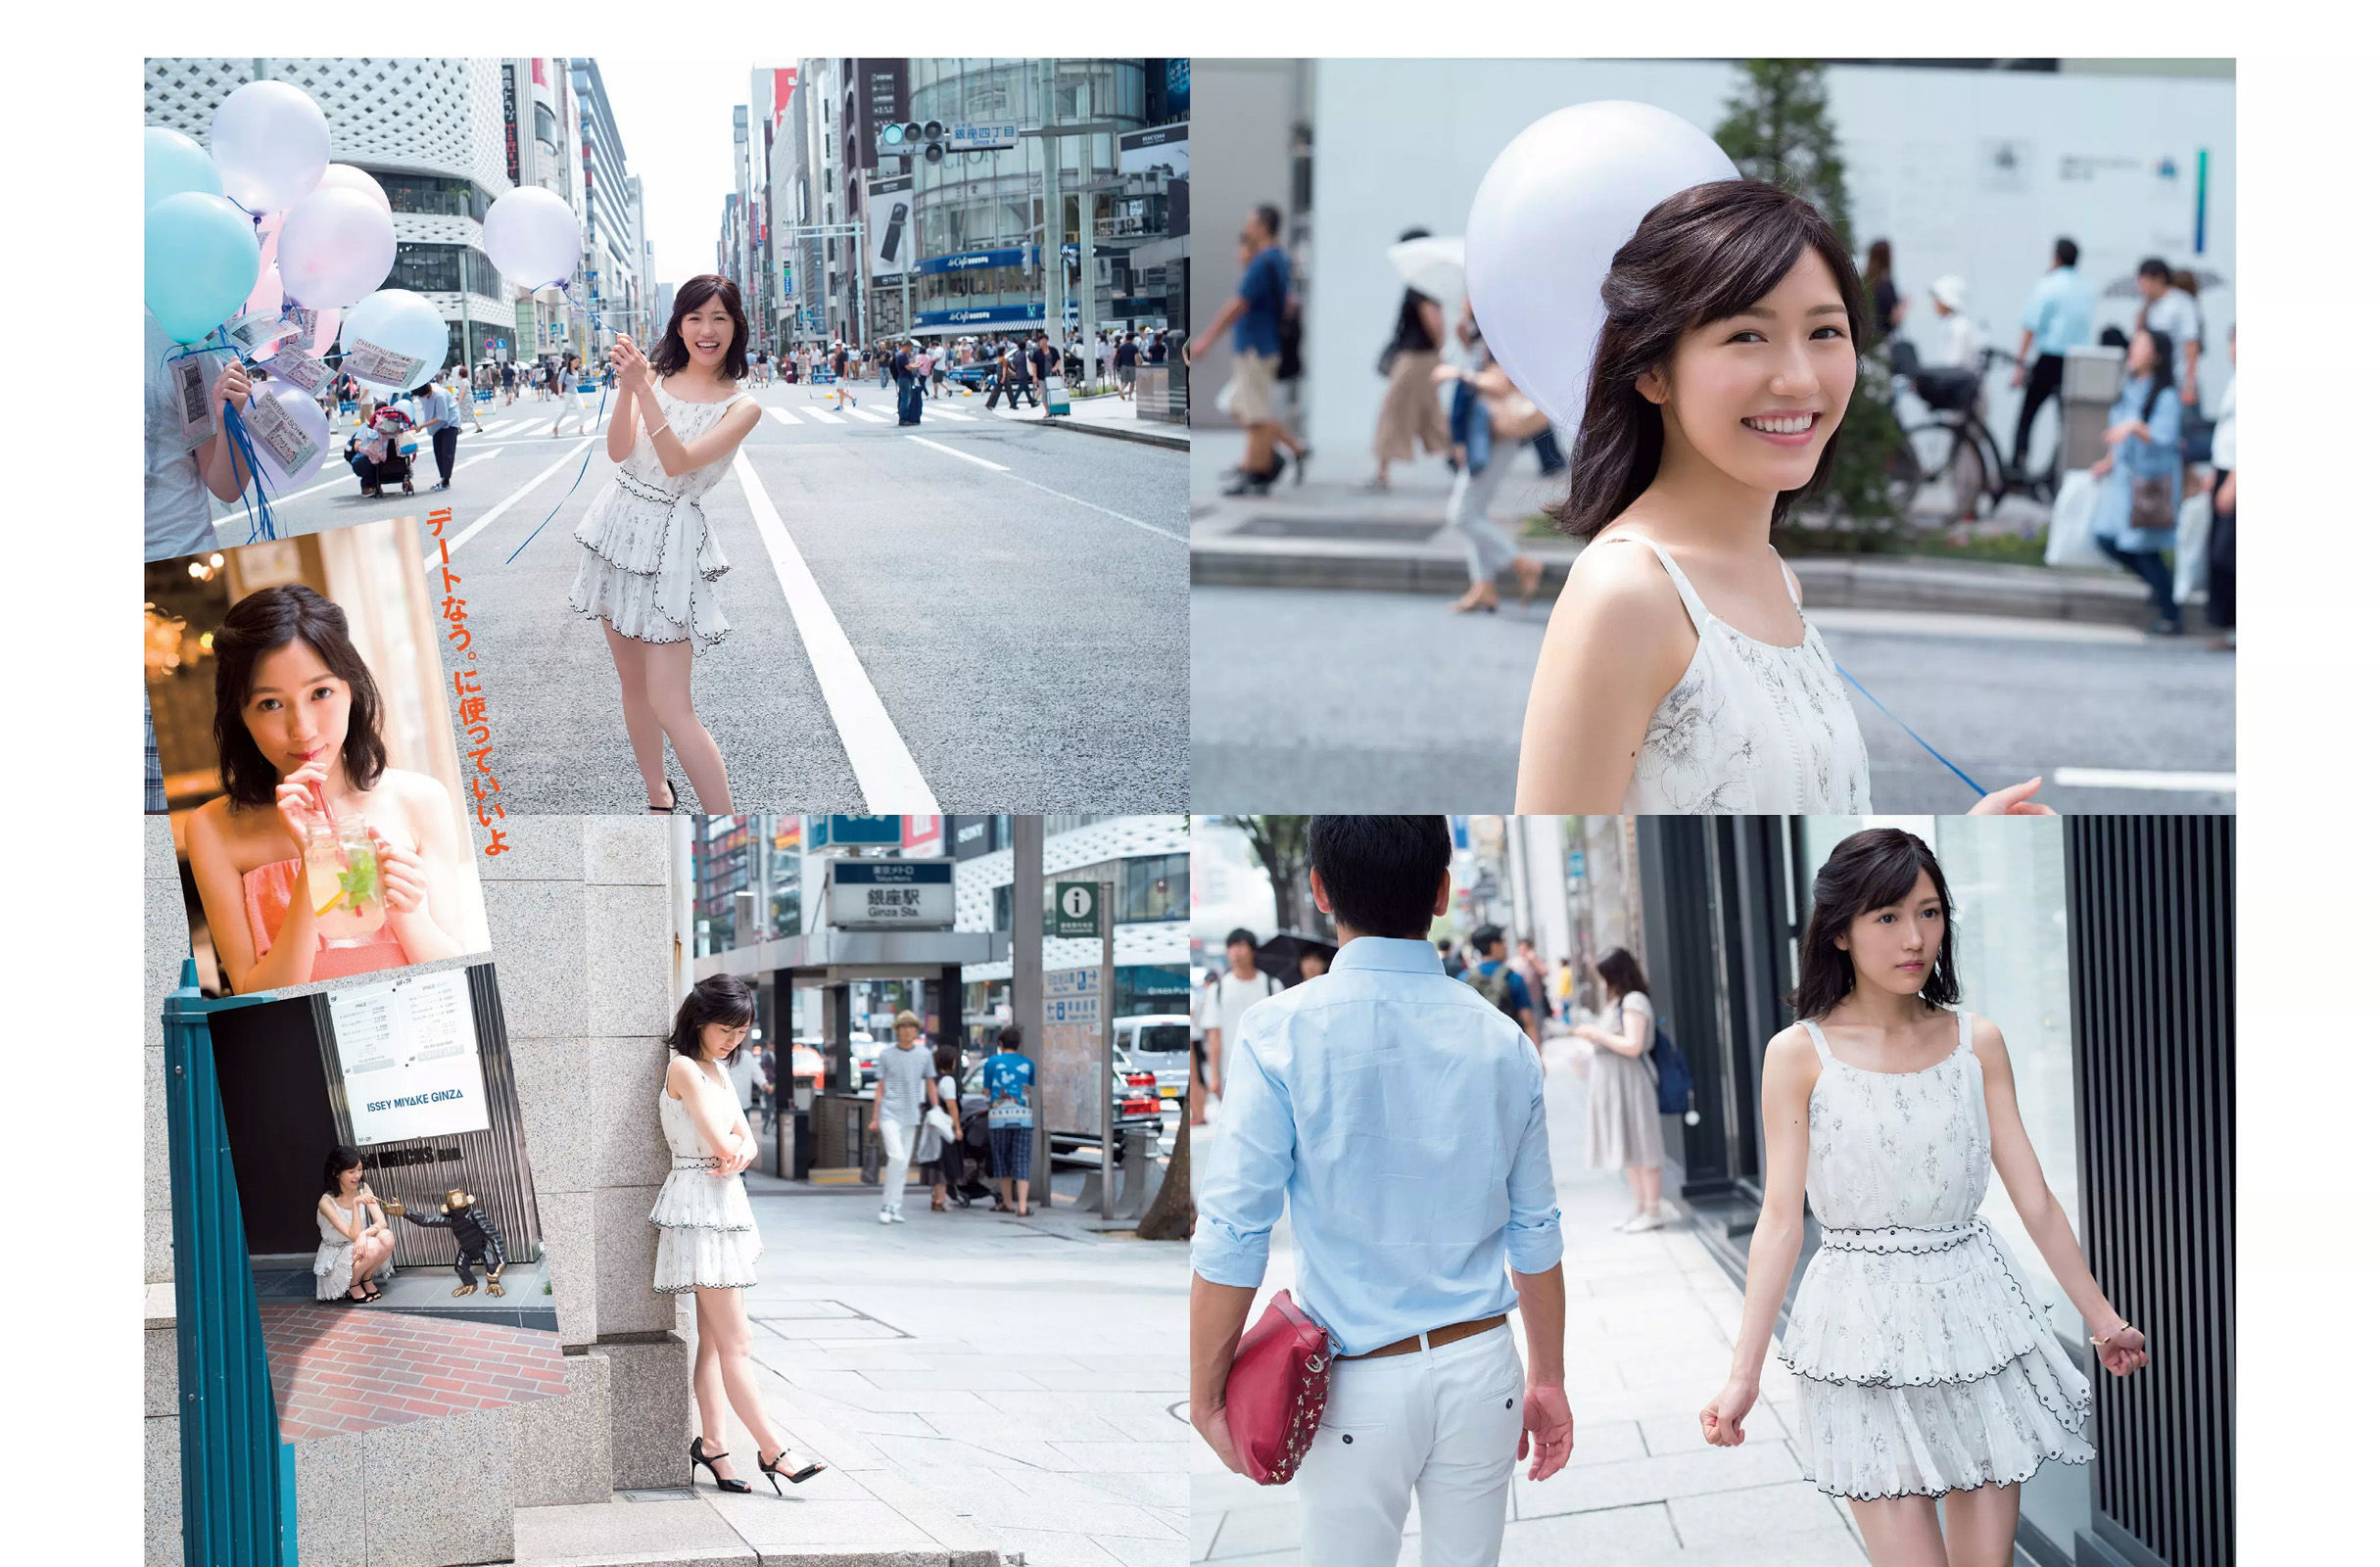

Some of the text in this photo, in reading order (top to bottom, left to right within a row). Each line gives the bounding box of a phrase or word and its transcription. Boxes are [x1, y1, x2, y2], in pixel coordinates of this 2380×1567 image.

[955, 125, 1015, 139] 銀座四丁目
[1142, 133, 1166, 142] RICOH
[264, 393, 290, 421] CHATEAU
[957, 823, 984, 843] SONY
[868, 888, 921, 906] 銀座駅
[868, 906, 919, 918] Ginza Sta.
[366, 1088, 464, 1113] ISSEY MIYAKE GINZA
